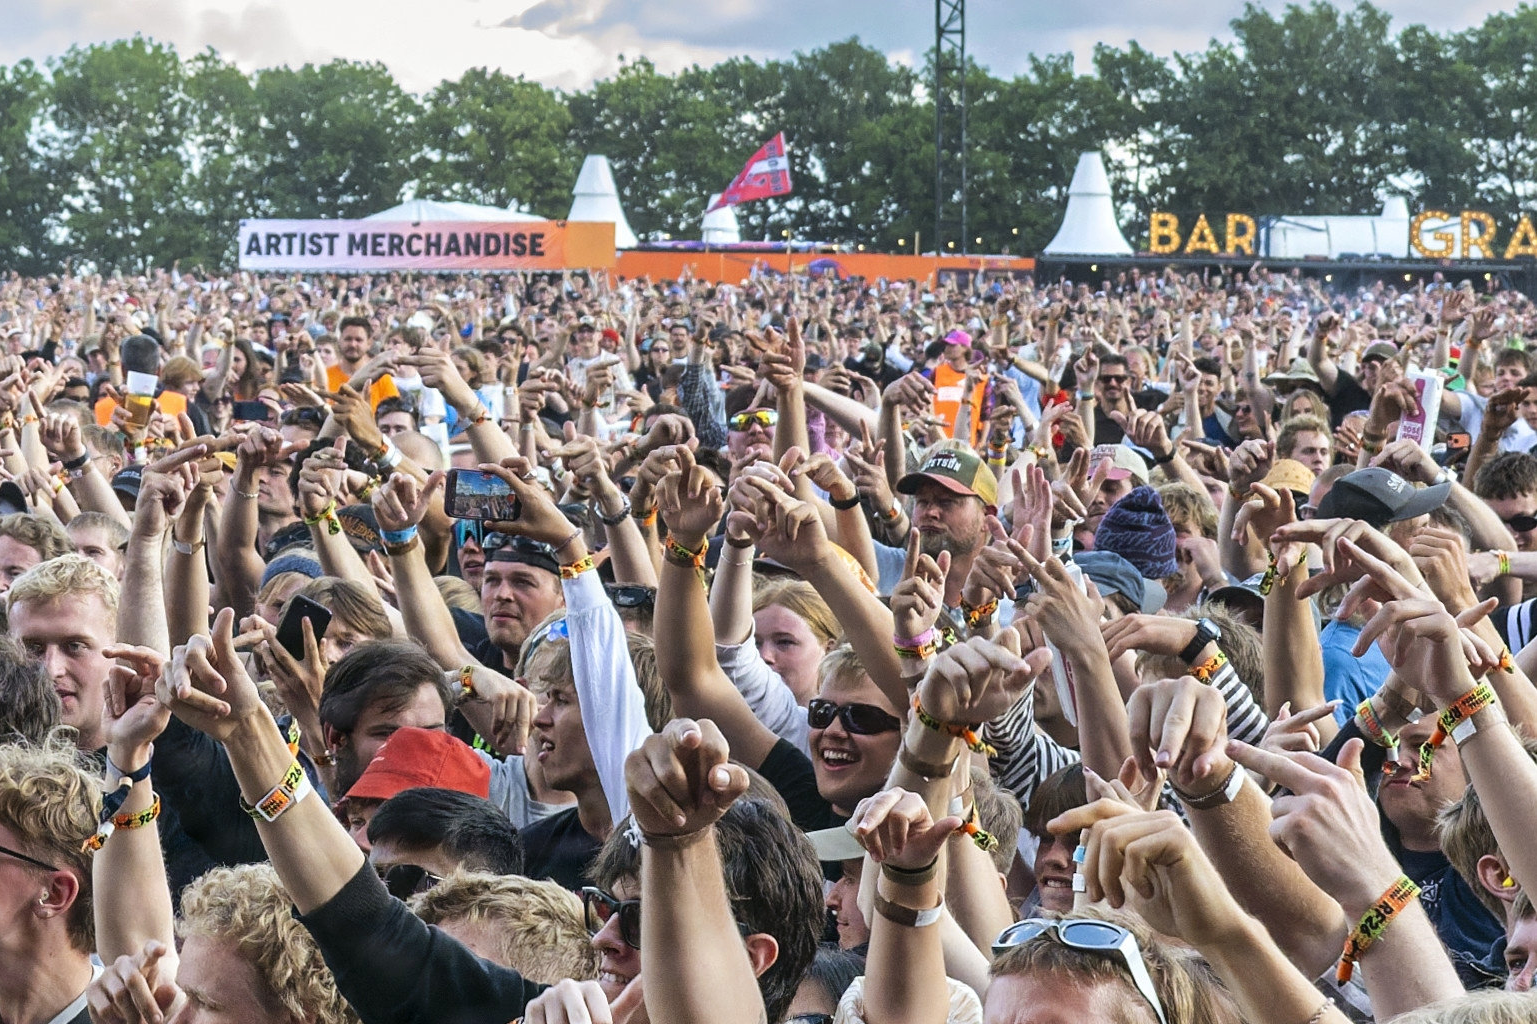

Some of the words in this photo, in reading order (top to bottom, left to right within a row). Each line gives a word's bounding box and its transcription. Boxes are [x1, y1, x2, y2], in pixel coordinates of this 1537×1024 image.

[246, 232, 340, 257] ARTIST
[347, 232, 545, 257] MERCHANDISE
[1150, 212, 1256, 255] BAR
[1411, 210, 1537, 260] GRA
[285, 766, 302, 793] F26
[1359, 900, 1395, 938] RF26
